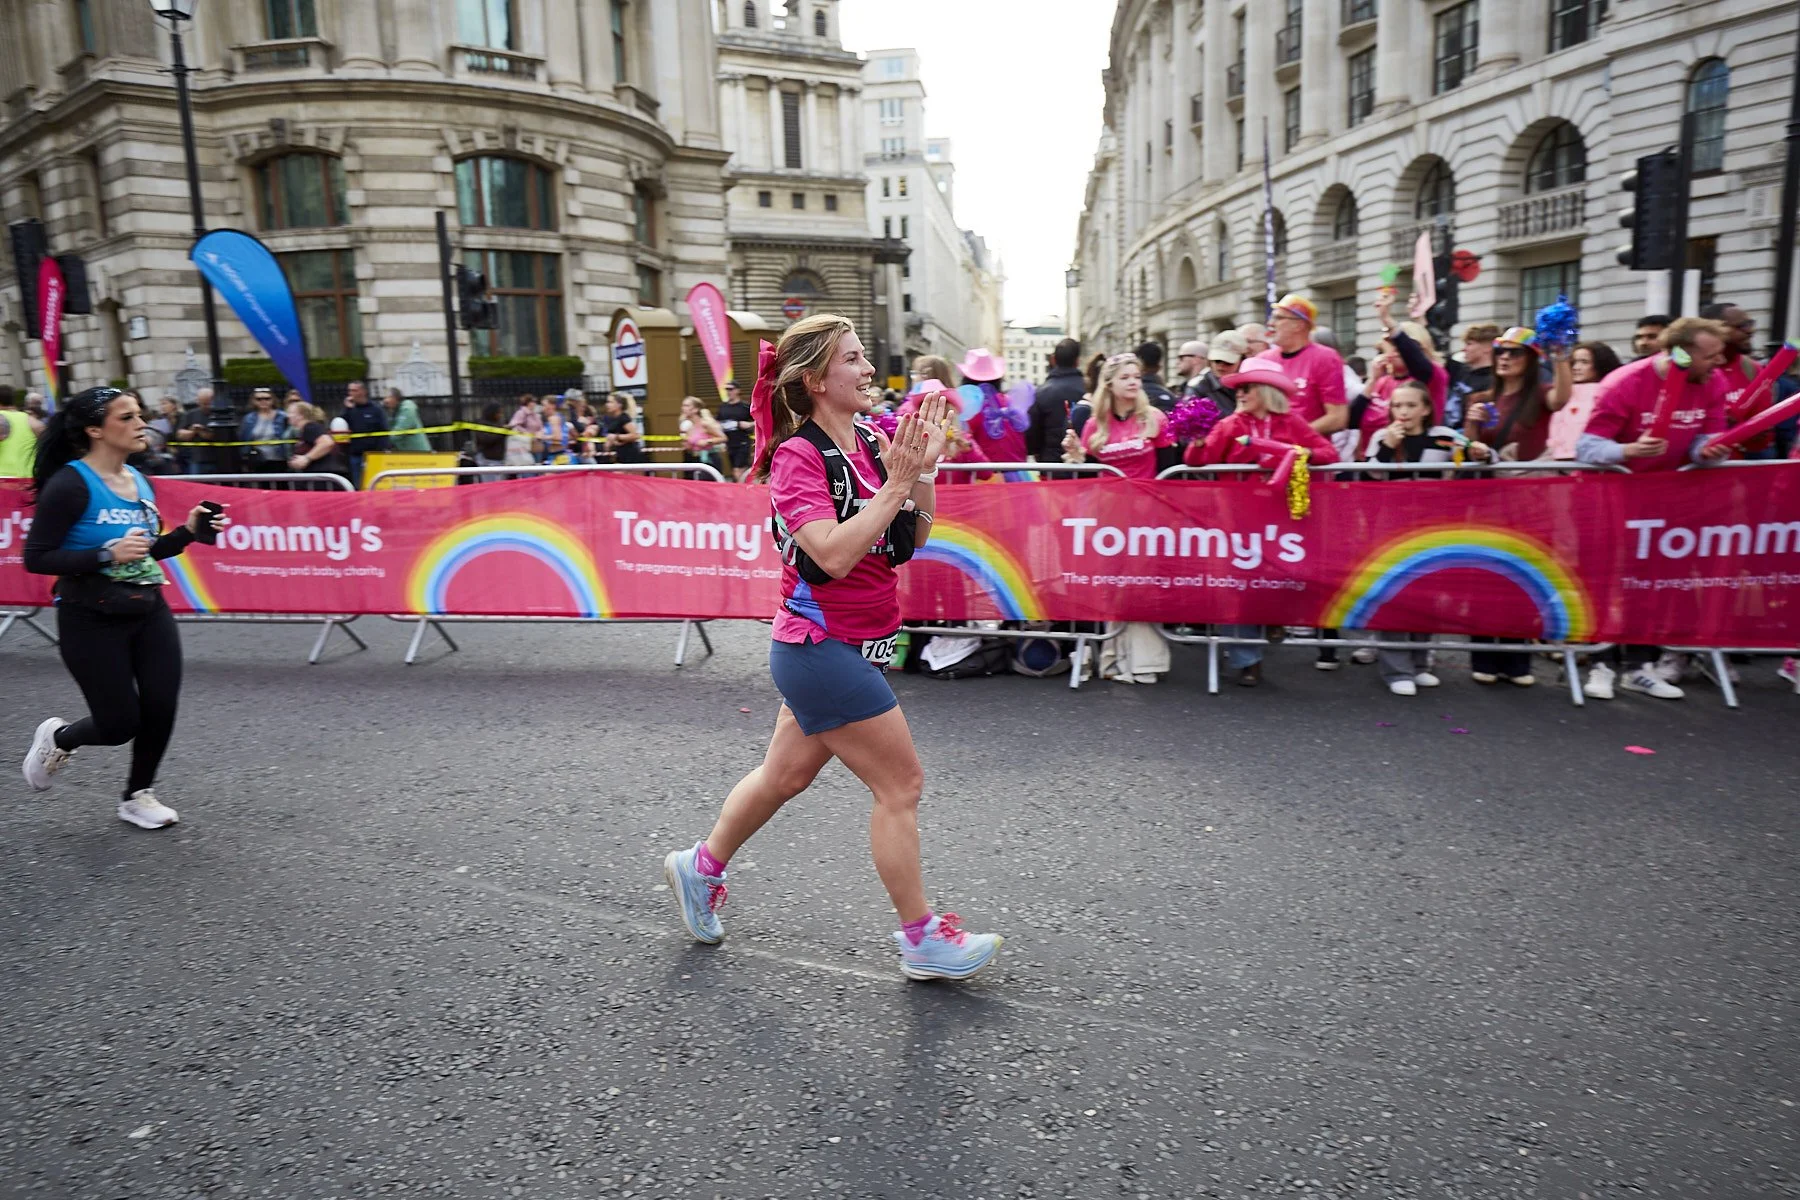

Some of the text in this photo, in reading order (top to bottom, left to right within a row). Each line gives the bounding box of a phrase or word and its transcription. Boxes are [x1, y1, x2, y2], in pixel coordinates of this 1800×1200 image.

[613, 510, 782, 561] Tommy'
[1062, 517, 1306, 569] Tommy's
[1625, 518, 1800, 560] Tomm
[213, 562, 386, 578] The pregnancy and baby charity
[614, 560, 634, 571] The
[635, 563, 692, 577] pregnancy
[694, 565, 717, 576] and
[718, 565, 750, 579] baby
[1061, 572, 1307, 592] The pregnancy and baby charity
[1621, 577, 1651, 589] The
[1654, 576, 1740, 591] pregnancy
[1743, 572, 1777, 585] and
